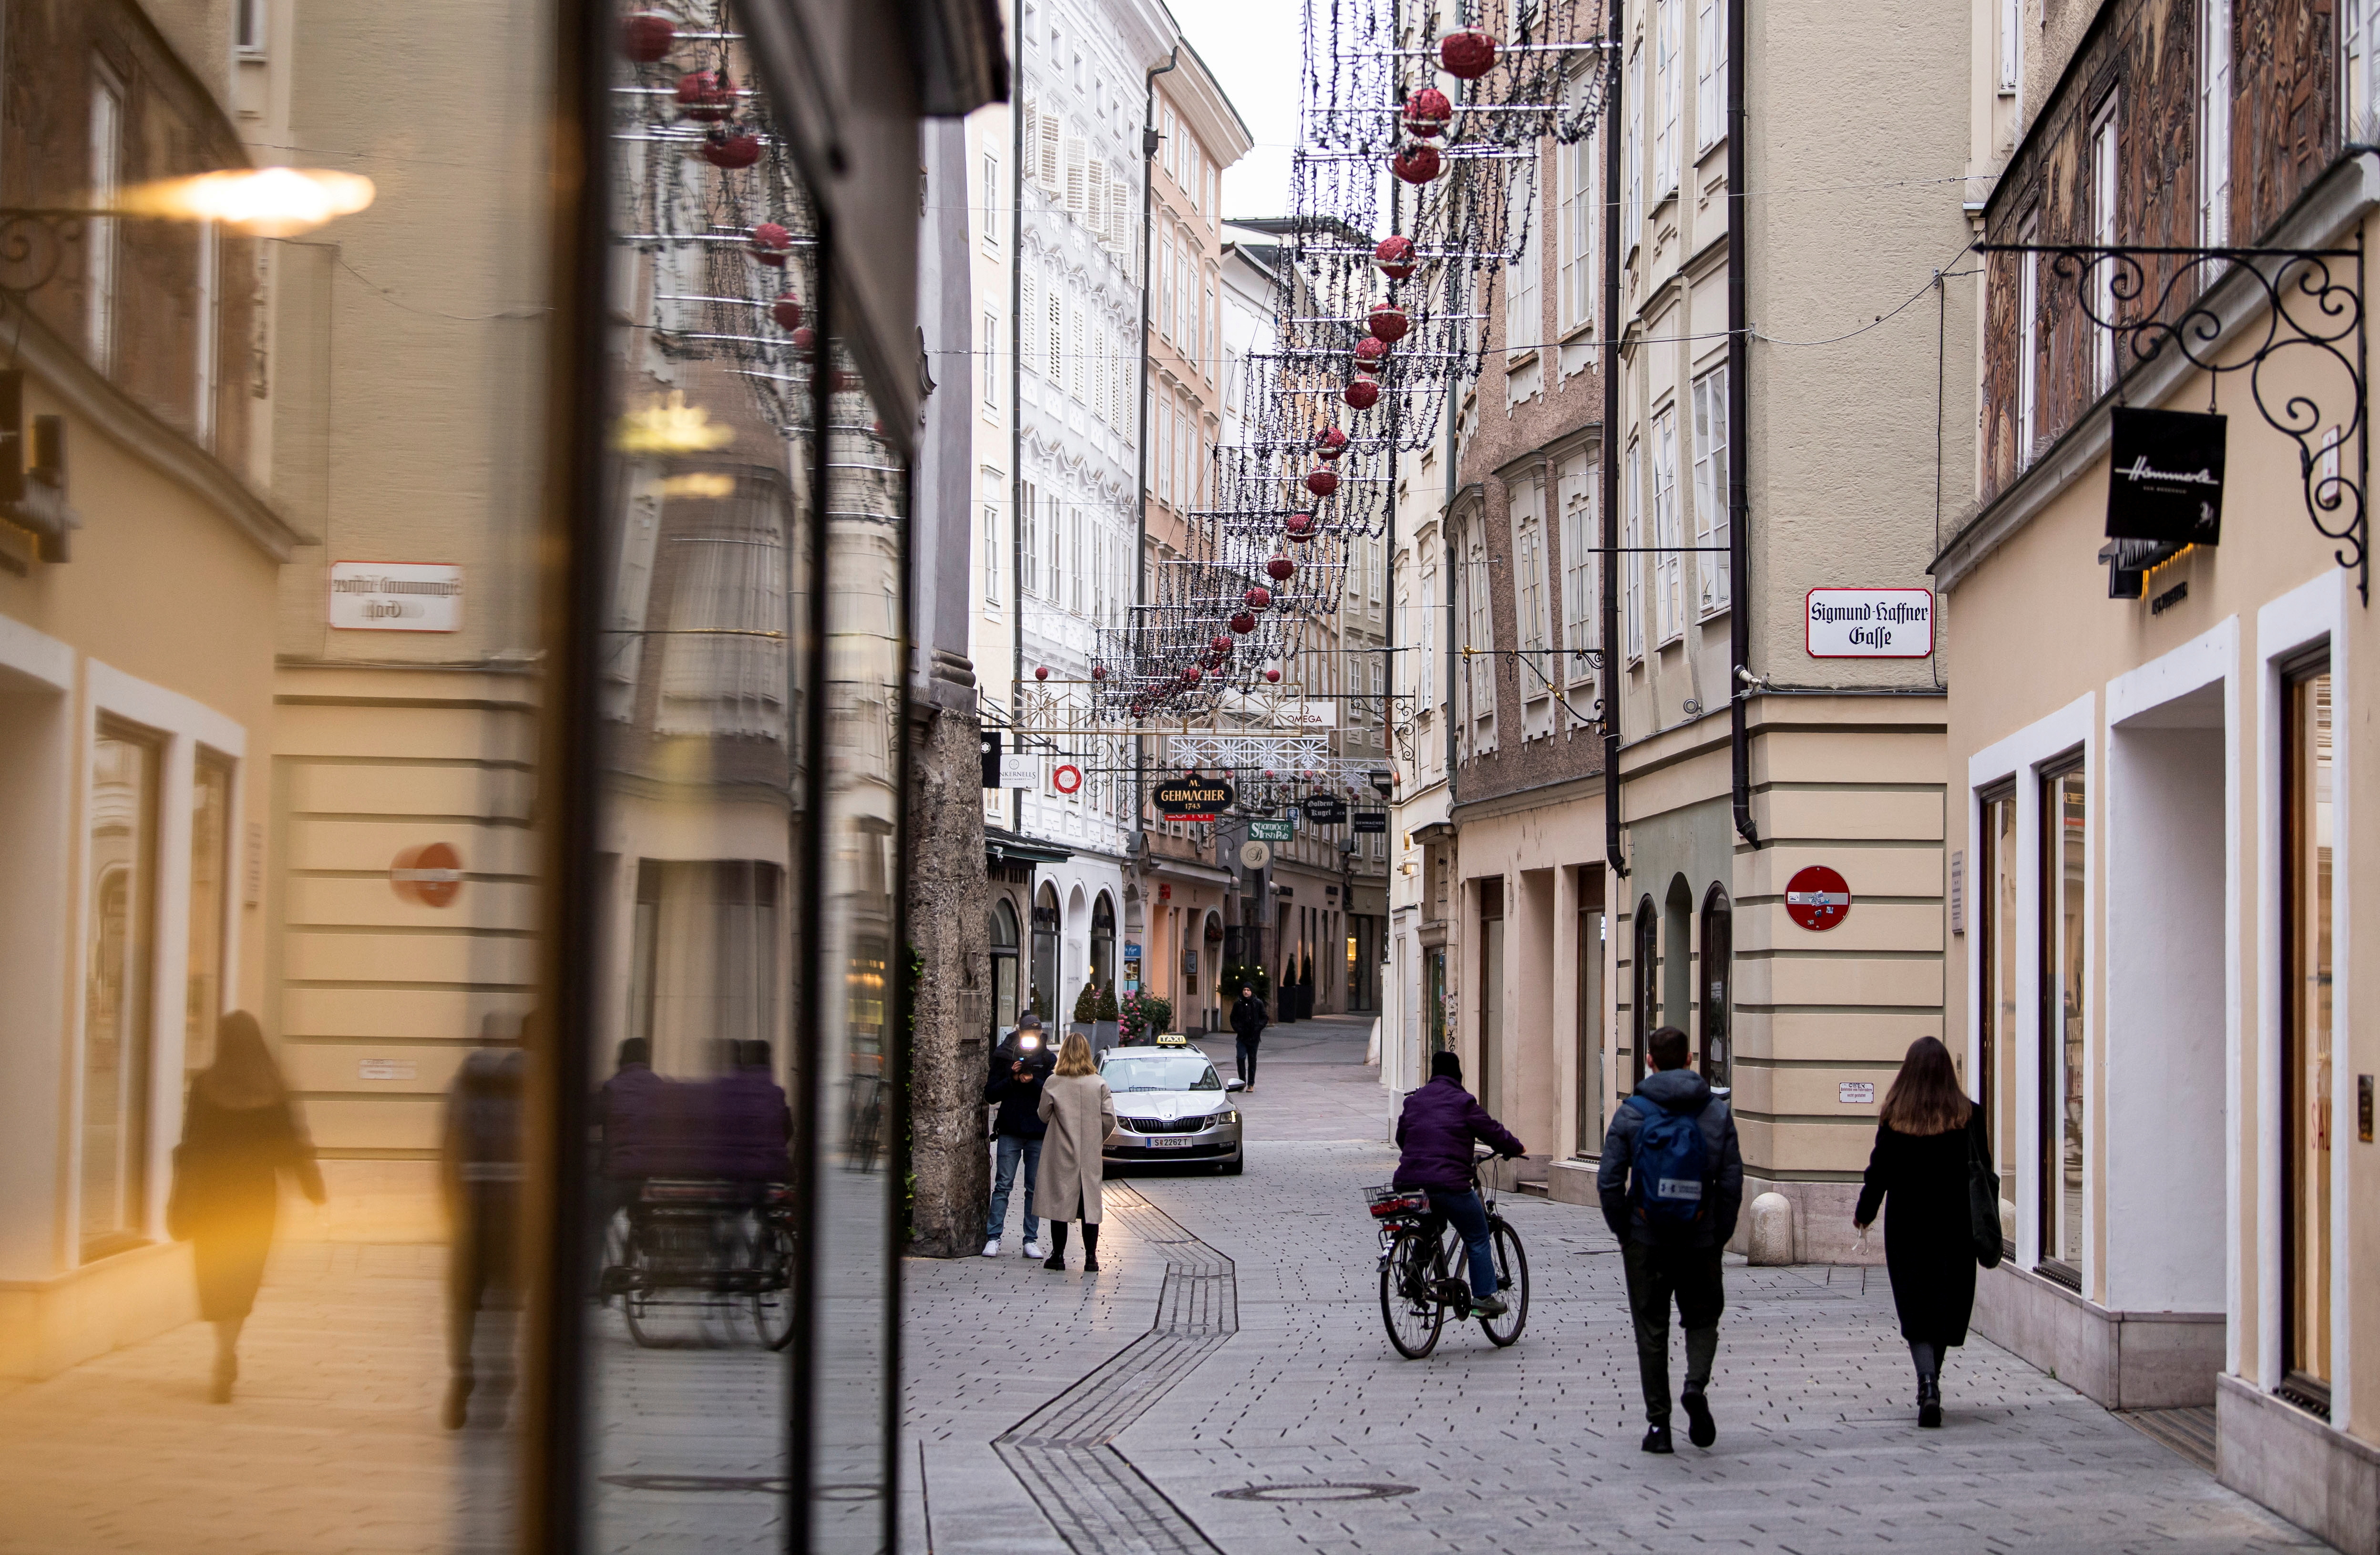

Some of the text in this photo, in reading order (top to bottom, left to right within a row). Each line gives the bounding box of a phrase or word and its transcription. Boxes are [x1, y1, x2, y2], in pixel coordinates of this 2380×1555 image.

[1849, 626, 1891, 649] Gasse
[1000, 771, 1036, 779] NKERNELLS
[1161, 790, 1225, 801] GEHMACHER
[1259, 830, 1288, 839] Irish Pub
